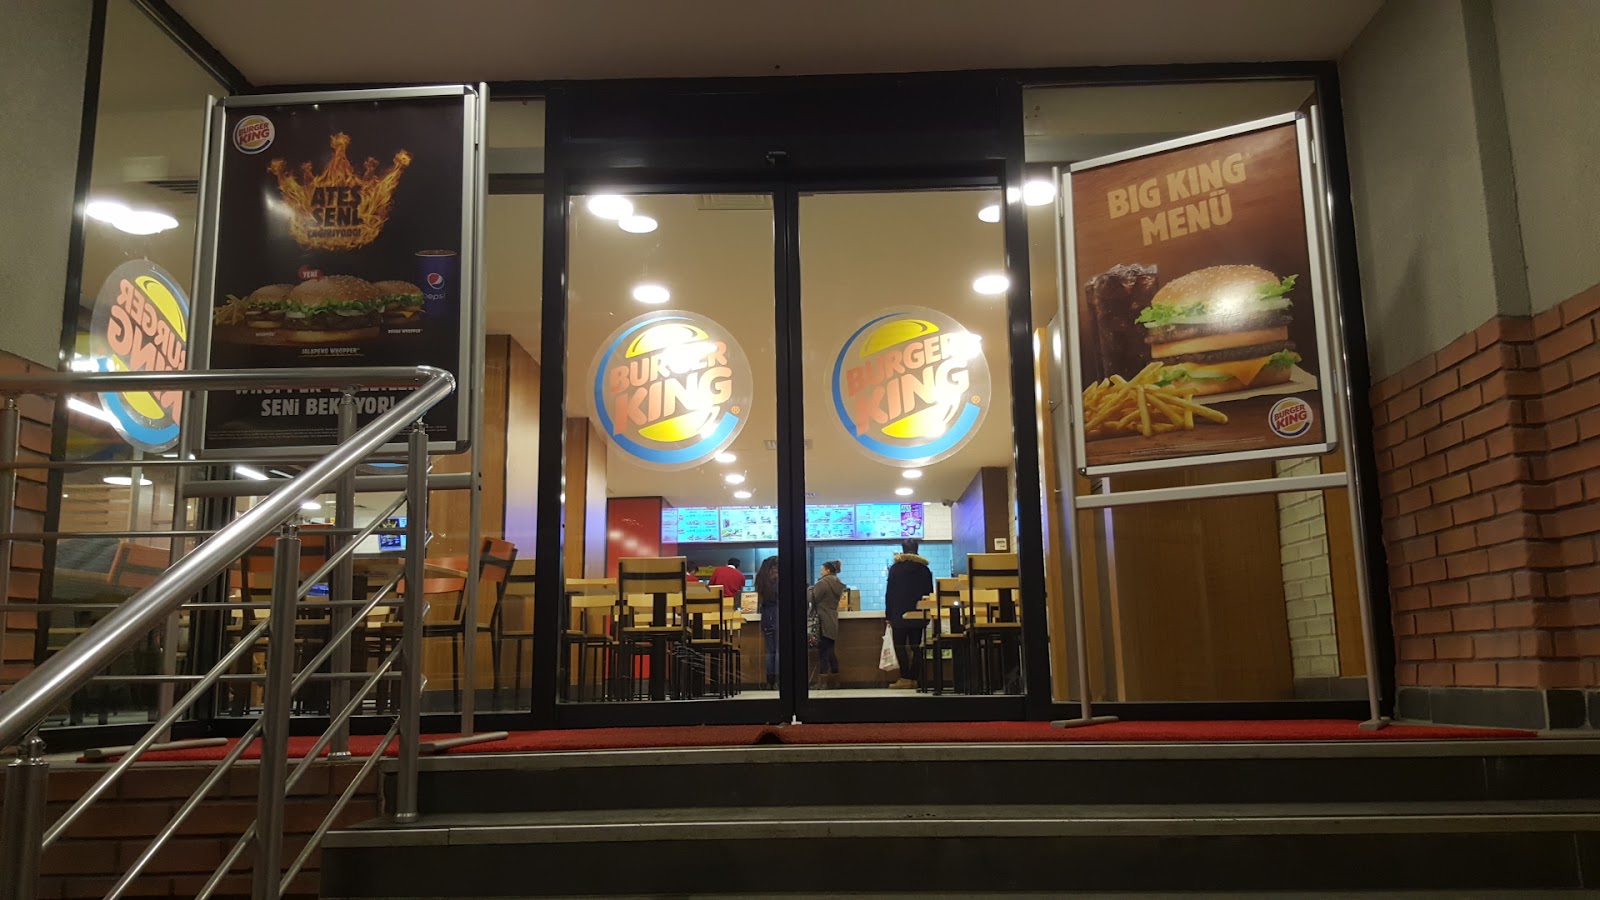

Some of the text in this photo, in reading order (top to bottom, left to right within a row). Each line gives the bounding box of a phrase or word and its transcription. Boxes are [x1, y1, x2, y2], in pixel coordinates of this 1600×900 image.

[239, 123, 269, 137] BURGER
[239, 129, 270, 145] KING
[1107, 152, 1247, 219] BIG KING
[1140, 189, 1233, 246] MENÜ
[846, 332, 965, 397] BURGER
[305, 396, 395, 416] BEKYOR!
[613, 367, 732, 436] KING
[855, 358, 970, 437] KING
[1274, 404, 1306, 421] BURGER
[1276, 410, 1308, 430] KING
